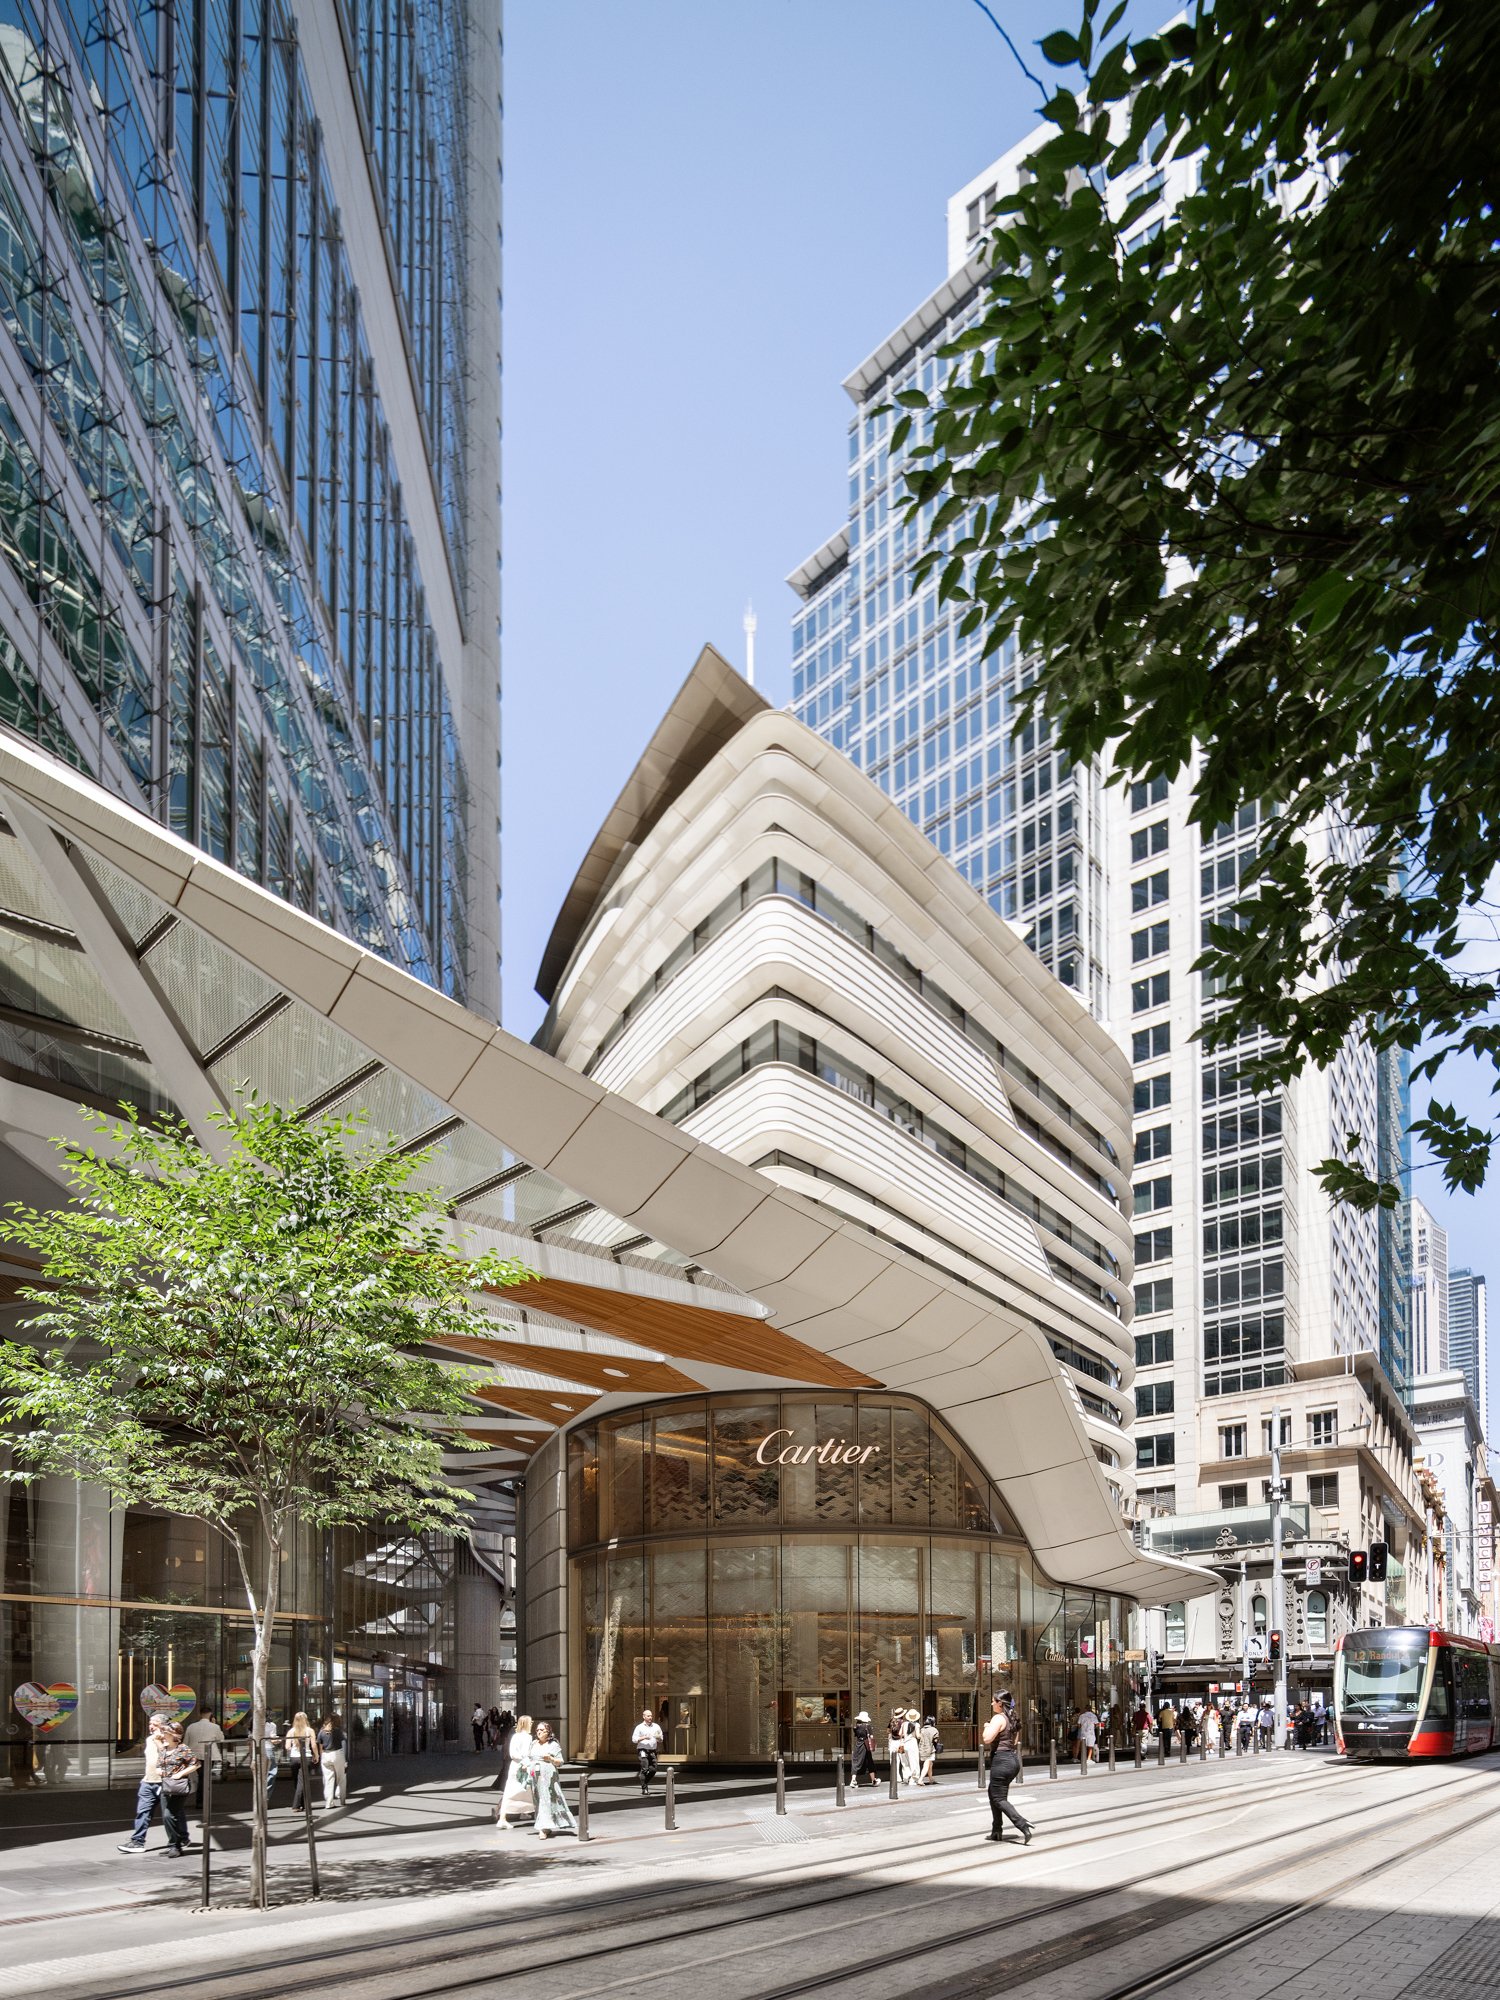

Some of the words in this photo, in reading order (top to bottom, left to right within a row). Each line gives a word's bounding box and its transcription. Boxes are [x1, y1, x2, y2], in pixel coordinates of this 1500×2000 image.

[756, 1428, 880, 1465] Cartier
[1480, 1503, 1490, 1579] DYMOCKS
[1354, 1650, 1366, 1661] L2
[1406, 1702, 1418, 1710] 53
